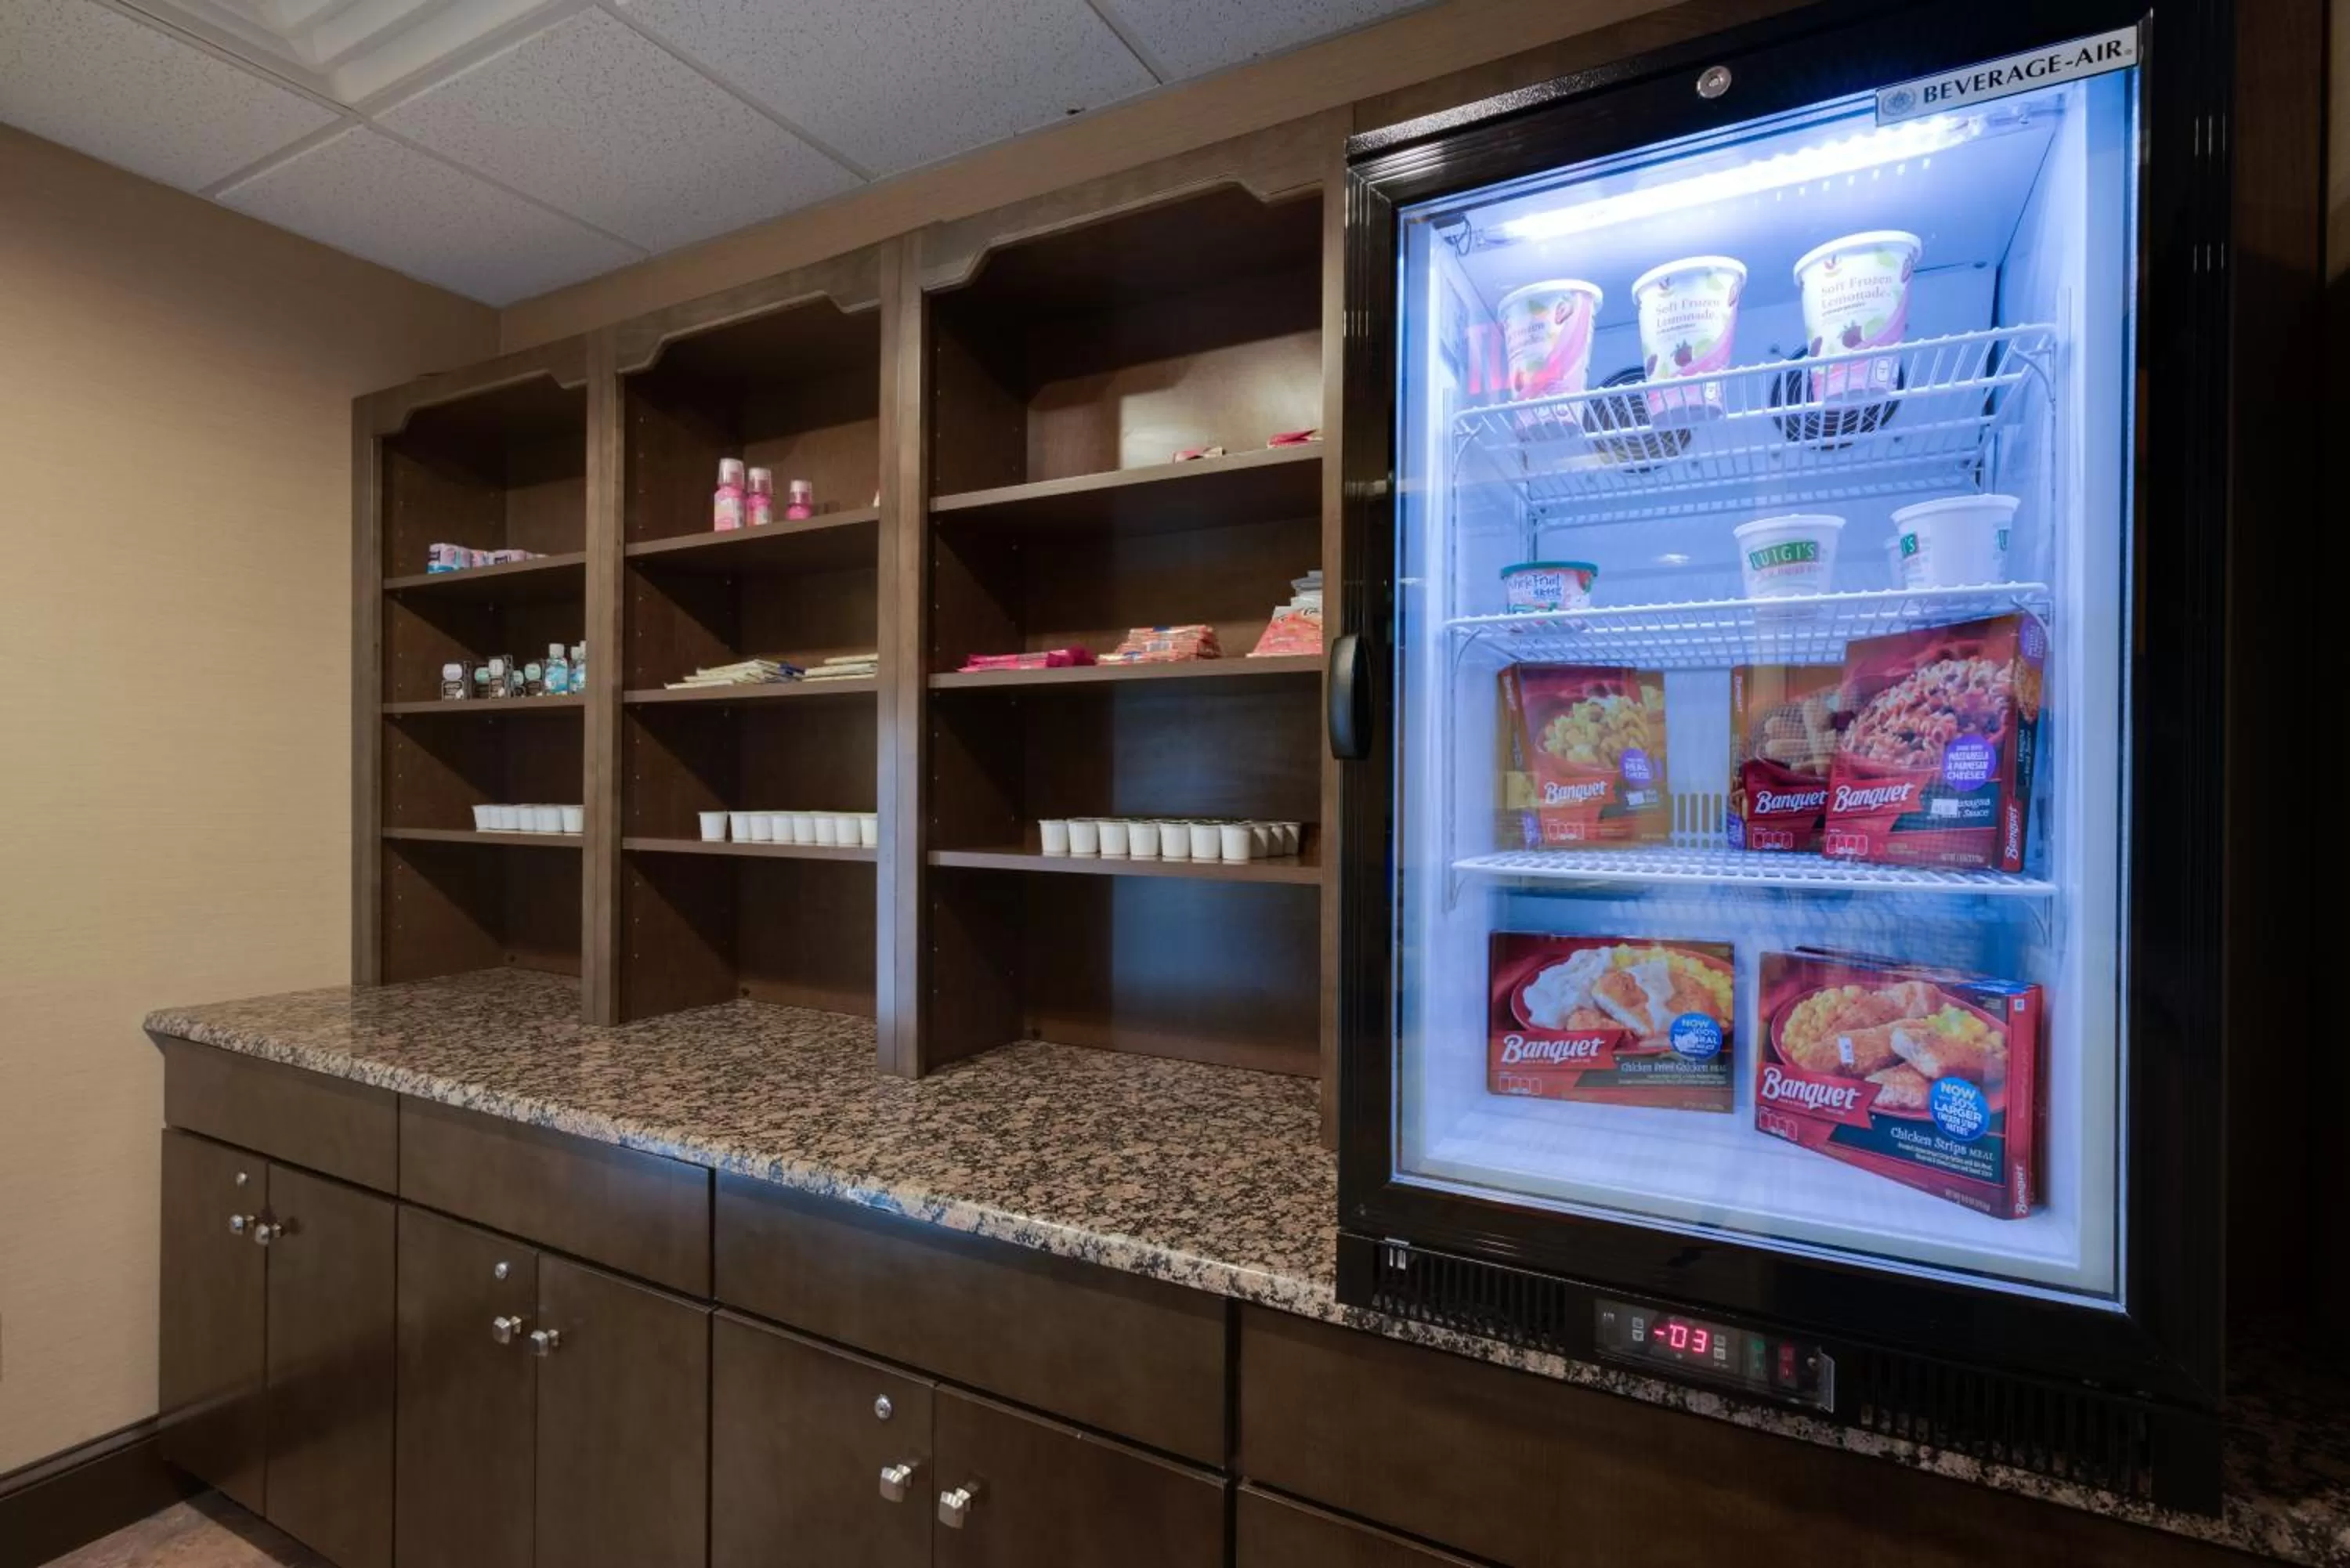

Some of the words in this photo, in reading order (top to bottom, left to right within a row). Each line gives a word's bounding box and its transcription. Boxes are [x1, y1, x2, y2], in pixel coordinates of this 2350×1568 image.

[1923, 40, 2122, 104] BEVERAGE-AIR
[1849, 275, 1893, 290] Frozen
[1750, 542, 1816, 570] LUIGI'S
[1544, 780, 1608, 805] Banquet
[1754, 790, 1829, 814] Banquet
[1833, 782, 1915, 813] Banquet
[2005, 804, 2019, 860] Banquet
[1682, 1019, 1711, 1028] NOW
[1501, 1034, 1605, 1064] Banquet
[1762, 1067, 1862, 1111] Banquet
[1940, 1082, 1976, 1100] NOW
[1934, 1100, 1983, 1123] LARGER
[1890, 1127, 1932, 1146] Chicken
[1934, 1137, 1967, 1156] Strips
